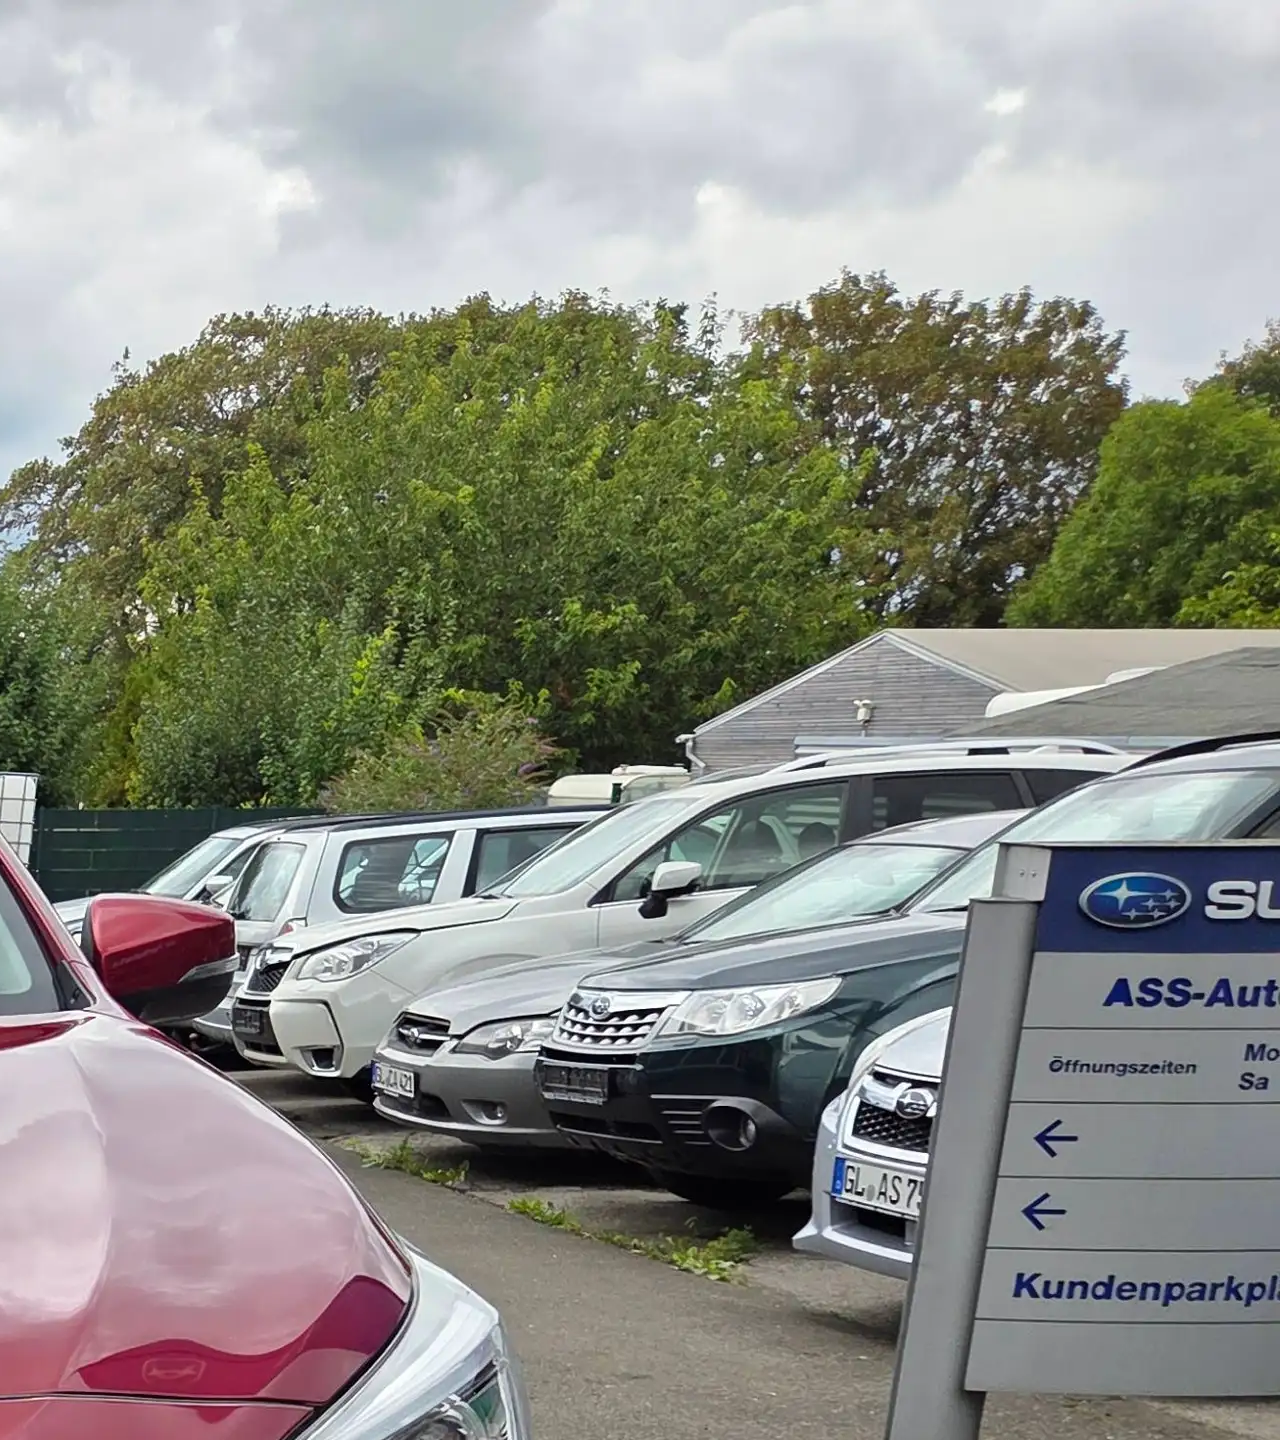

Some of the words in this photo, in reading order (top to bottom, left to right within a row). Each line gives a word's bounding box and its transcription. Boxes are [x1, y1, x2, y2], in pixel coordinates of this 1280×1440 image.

[1102, 977, 1280, 1008] ASS-Aut
[1048, 1055, 1197, 1077] Öffnungszeiten
[1238, 1071, 1269, 1091] Sa
[1012, 1272, 1280, 1307] Kundenparkpl
